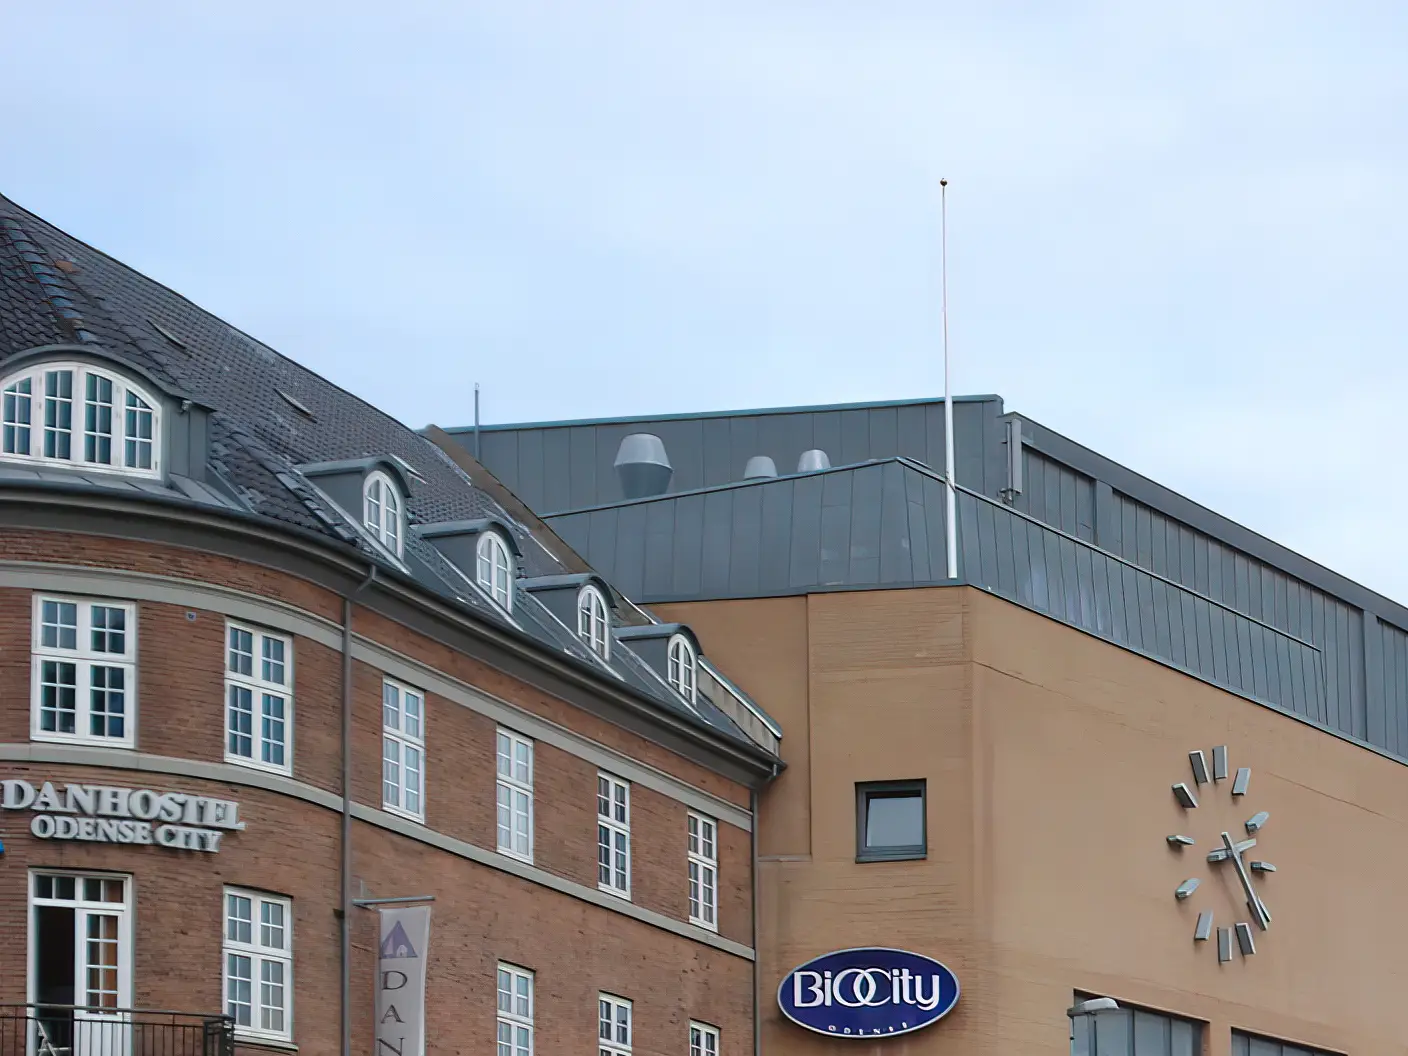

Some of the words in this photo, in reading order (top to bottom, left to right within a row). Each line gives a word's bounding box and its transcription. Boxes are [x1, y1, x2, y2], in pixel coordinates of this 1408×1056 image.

[1, 779, 247, 831] DANHOSTEL
[31, 814, 152, 844] ODENSE
[154, 824, 223, 853] CITY
